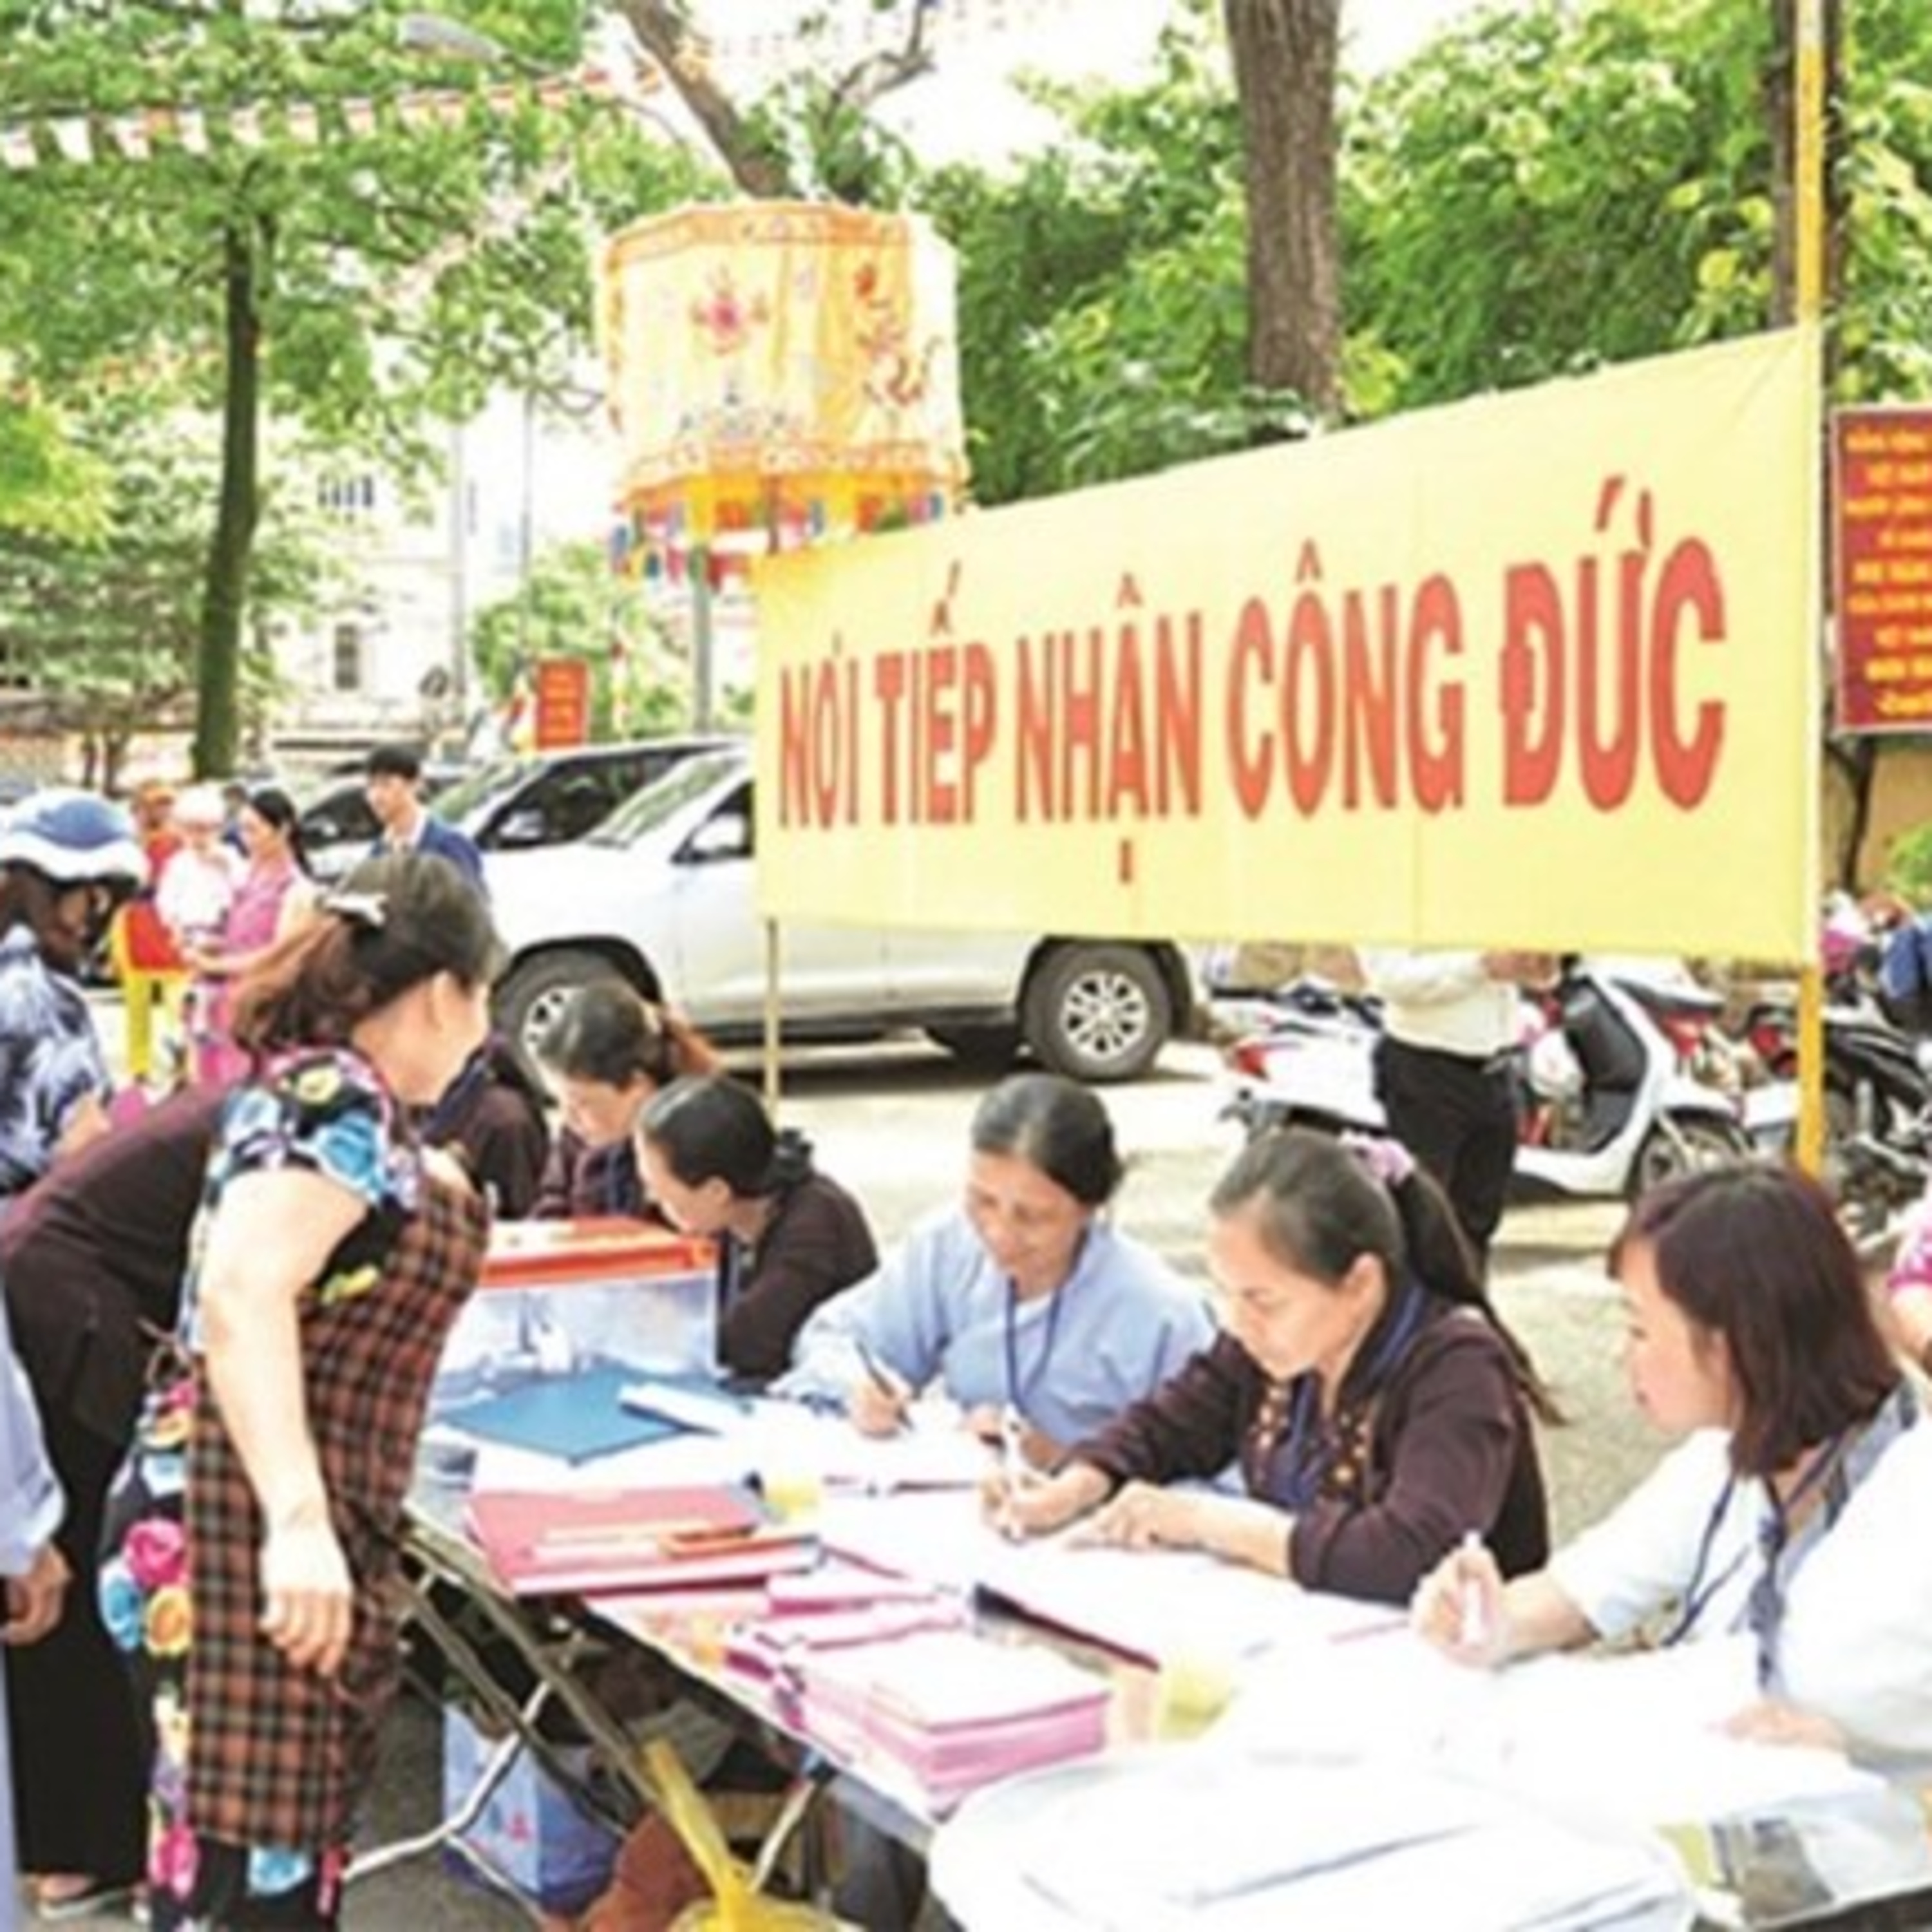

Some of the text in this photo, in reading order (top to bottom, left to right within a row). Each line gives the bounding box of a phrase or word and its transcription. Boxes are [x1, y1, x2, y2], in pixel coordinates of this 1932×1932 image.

[874, 559, 998, 826] TIẾP
[1014, 573, 1202, 885] NHẬN
[1224, 538, 1465, 822] CÔNG
[1497, 474, 1727, 814] ĐỨC
